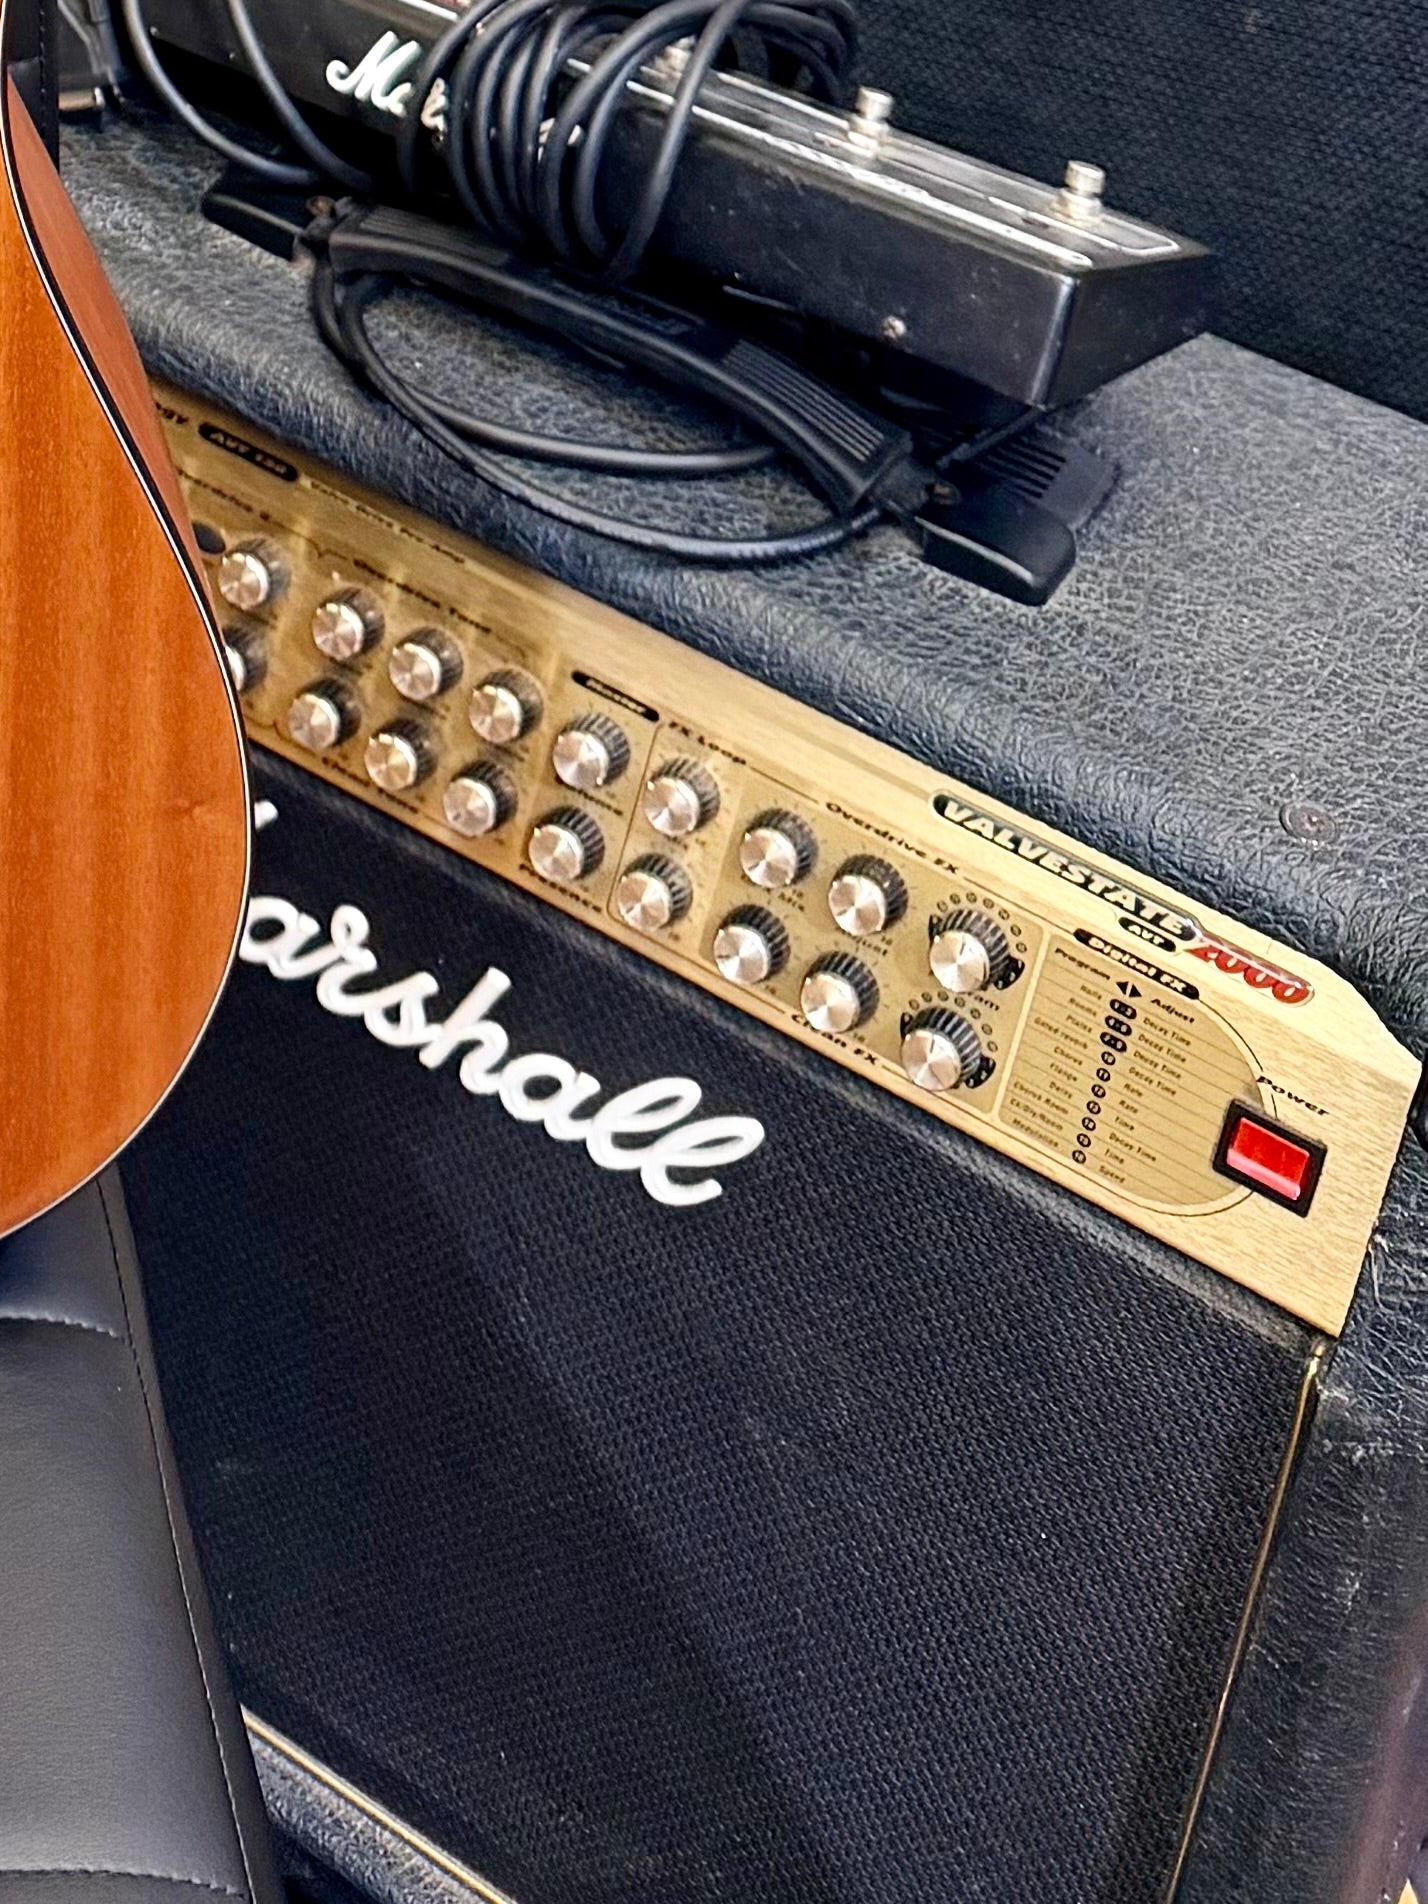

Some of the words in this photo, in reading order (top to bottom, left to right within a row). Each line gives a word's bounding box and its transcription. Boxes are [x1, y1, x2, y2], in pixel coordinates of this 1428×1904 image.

[352, 558, 441, 610] Overdrive
[449, 606, 492, 634] Tone
[668, 721, 691, 738] FX
[697, 736, 747, 766] Loop
[825, 801, 928, 859] Overdrive
[934, 857, 961, 875] FX
[943, 799, 1186, 936] VALVESTATE
[1127, 921, 1168, 948] AVT
[1087, 935, 1158, 981] Digital
[1159, 968, 1189, 992] FX
[1054, 947, 1111, 981] Program
[1150, 997, 1195, 1024] Adjust
[239, 832, 766, 1206] arshall
[1068, 997, 1097, 1018] Rooms
[1137, 1033, 1163, 1053] Decay
[1165, 1046, 1187, 1063] Time
[1142, 1016, 1168, 1037] Decay
[1170, 1030, 1192, 1047] Time
[853, 1047, 879, 1066] FX
[1053, 1045, 1084, 1066] Chorus
[1123, 1082, 1144, 1098] Rate
[1132, 1049, 1158, 1069] Decay
[1160, 1062, 1182, 1080] Time
[1128, 1066, 1154, 1086] Decay
[1156, 1079, 1177, 1097] Time
[1256, 1075, 1330, 1116] Power
[1114, 1115, 1135, 1132] Time
[1118, 1099, 1140, 1115] Rate
[1104, 1148, 1126, 1165] Time
[1109, 1131, 1135, 1152] Decay
[1135, 1145, 1157, 1163] Time
[1098, 1164, 1126, 1185] Speed
